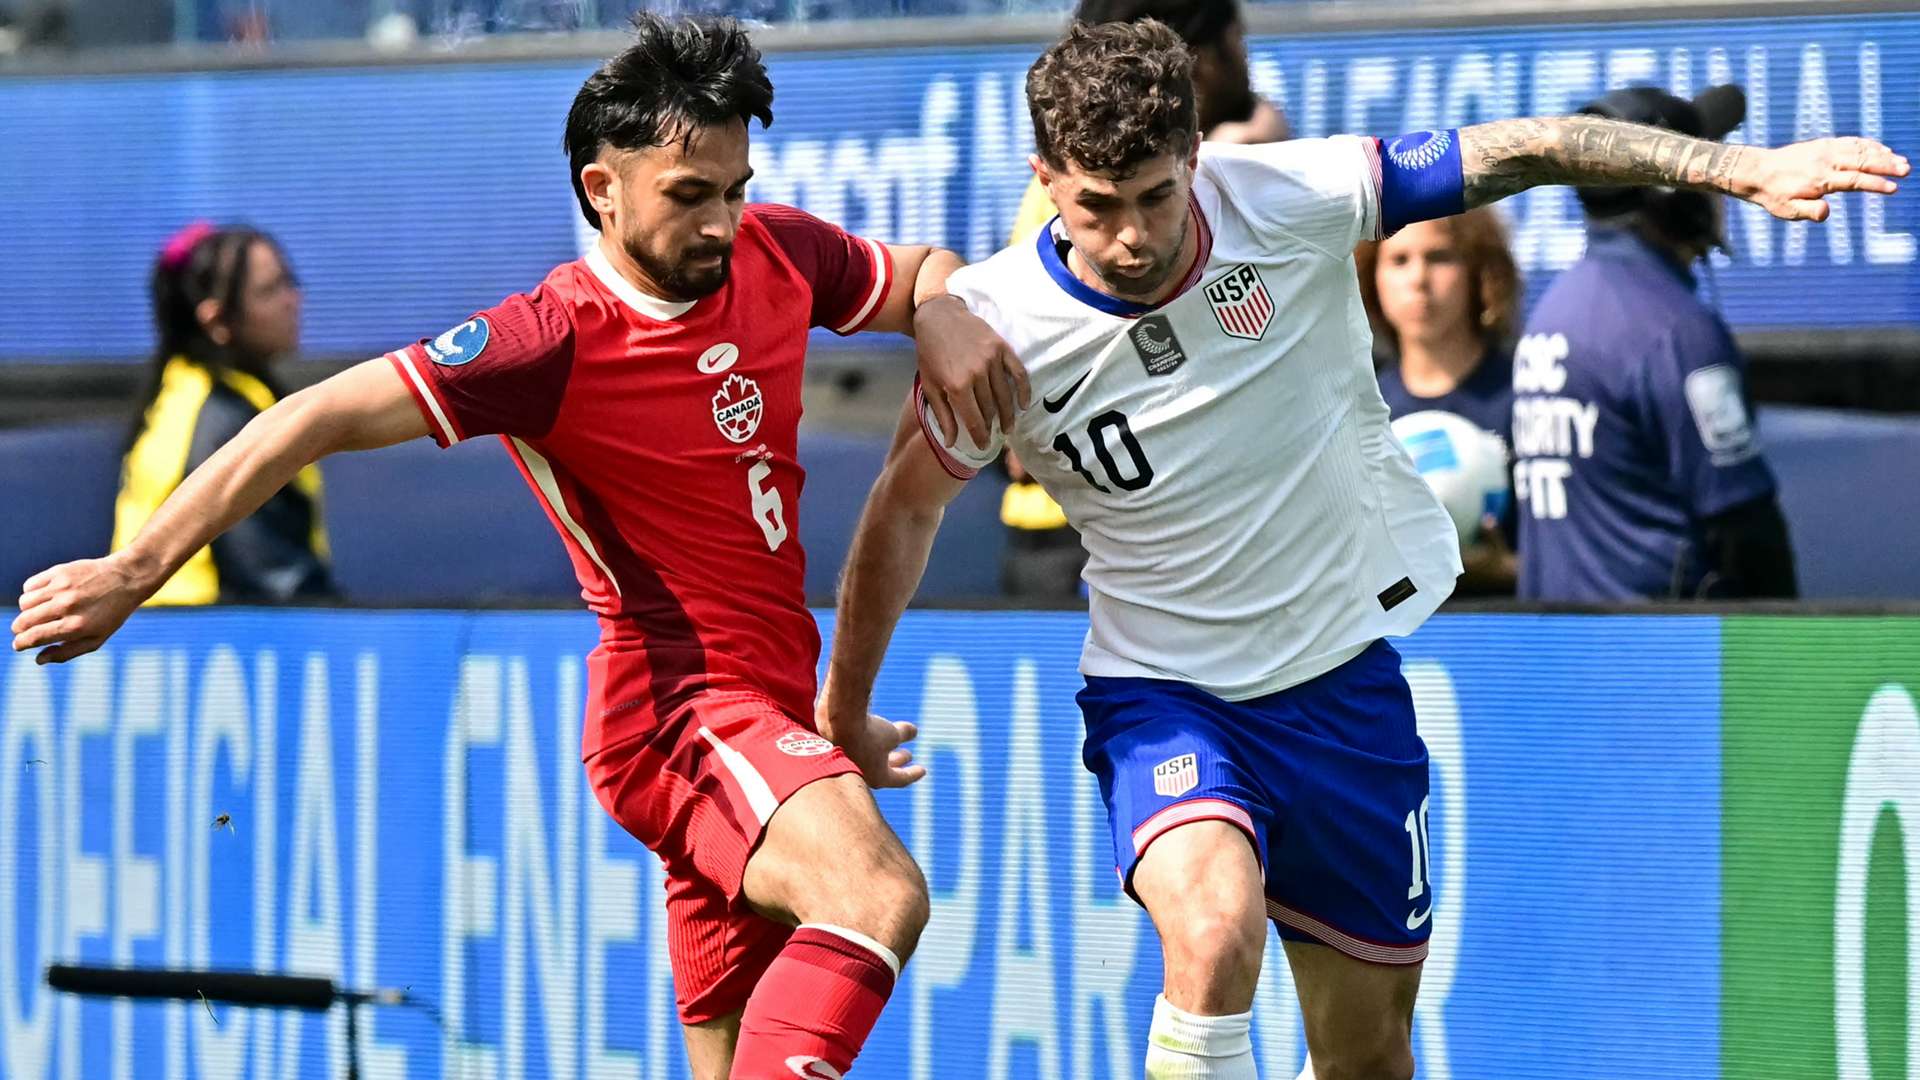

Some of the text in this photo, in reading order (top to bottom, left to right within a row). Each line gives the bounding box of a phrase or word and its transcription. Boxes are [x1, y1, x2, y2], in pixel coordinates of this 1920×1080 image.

[1209, 265, 1256, 303] USA
[717, 396, 761, 422] CANADA
[1053, 409, 1154, 494] 10
[748, 460, 788, 552] 6
[1156, 756, 1193, 776] USA
[3, 642, 410, 1080] OFFICIAL
